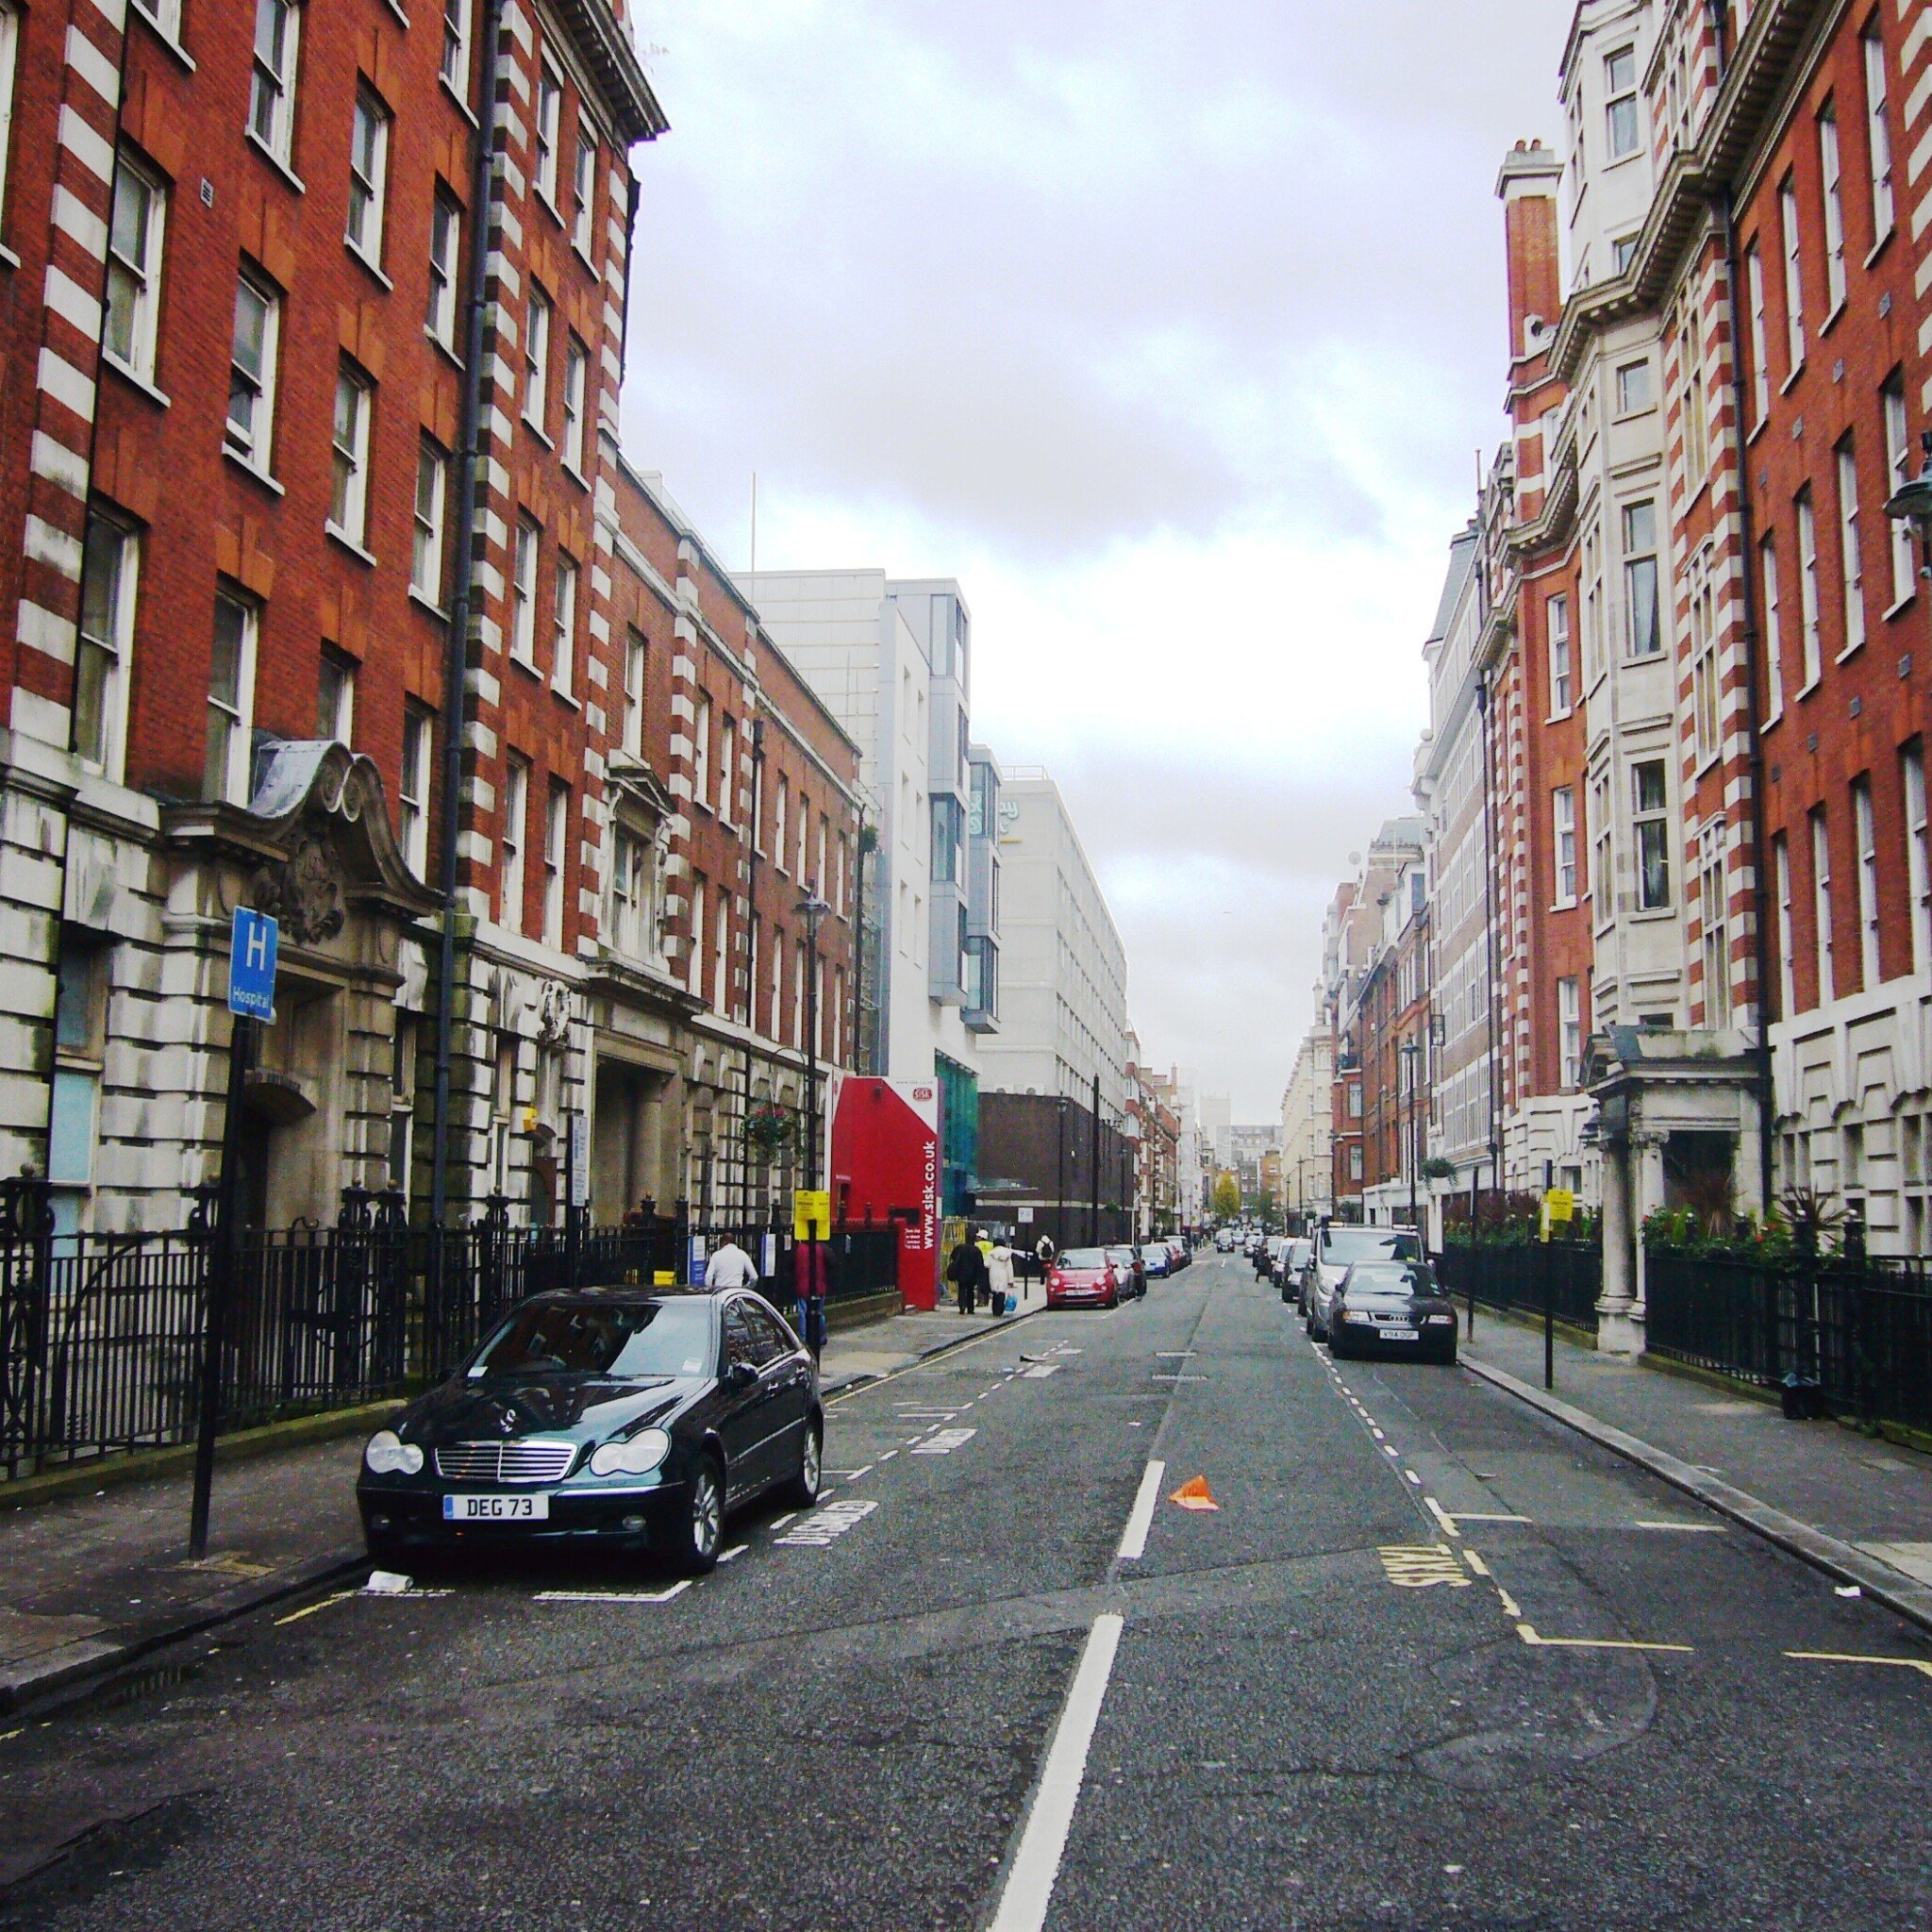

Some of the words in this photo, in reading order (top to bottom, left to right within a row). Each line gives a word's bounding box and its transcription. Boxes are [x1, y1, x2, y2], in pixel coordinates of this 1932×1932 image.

[246, 922, 267, 971] H
[232, 986, 270, 1009] Hospital
[922, 1141, 936, 1250] www.sisk.co.uk
[467, 1498, 503, 1516] DEG
[508, 1498, 533, 1516] 73
[1376, 1543, 1473, 1588] TAXIS
